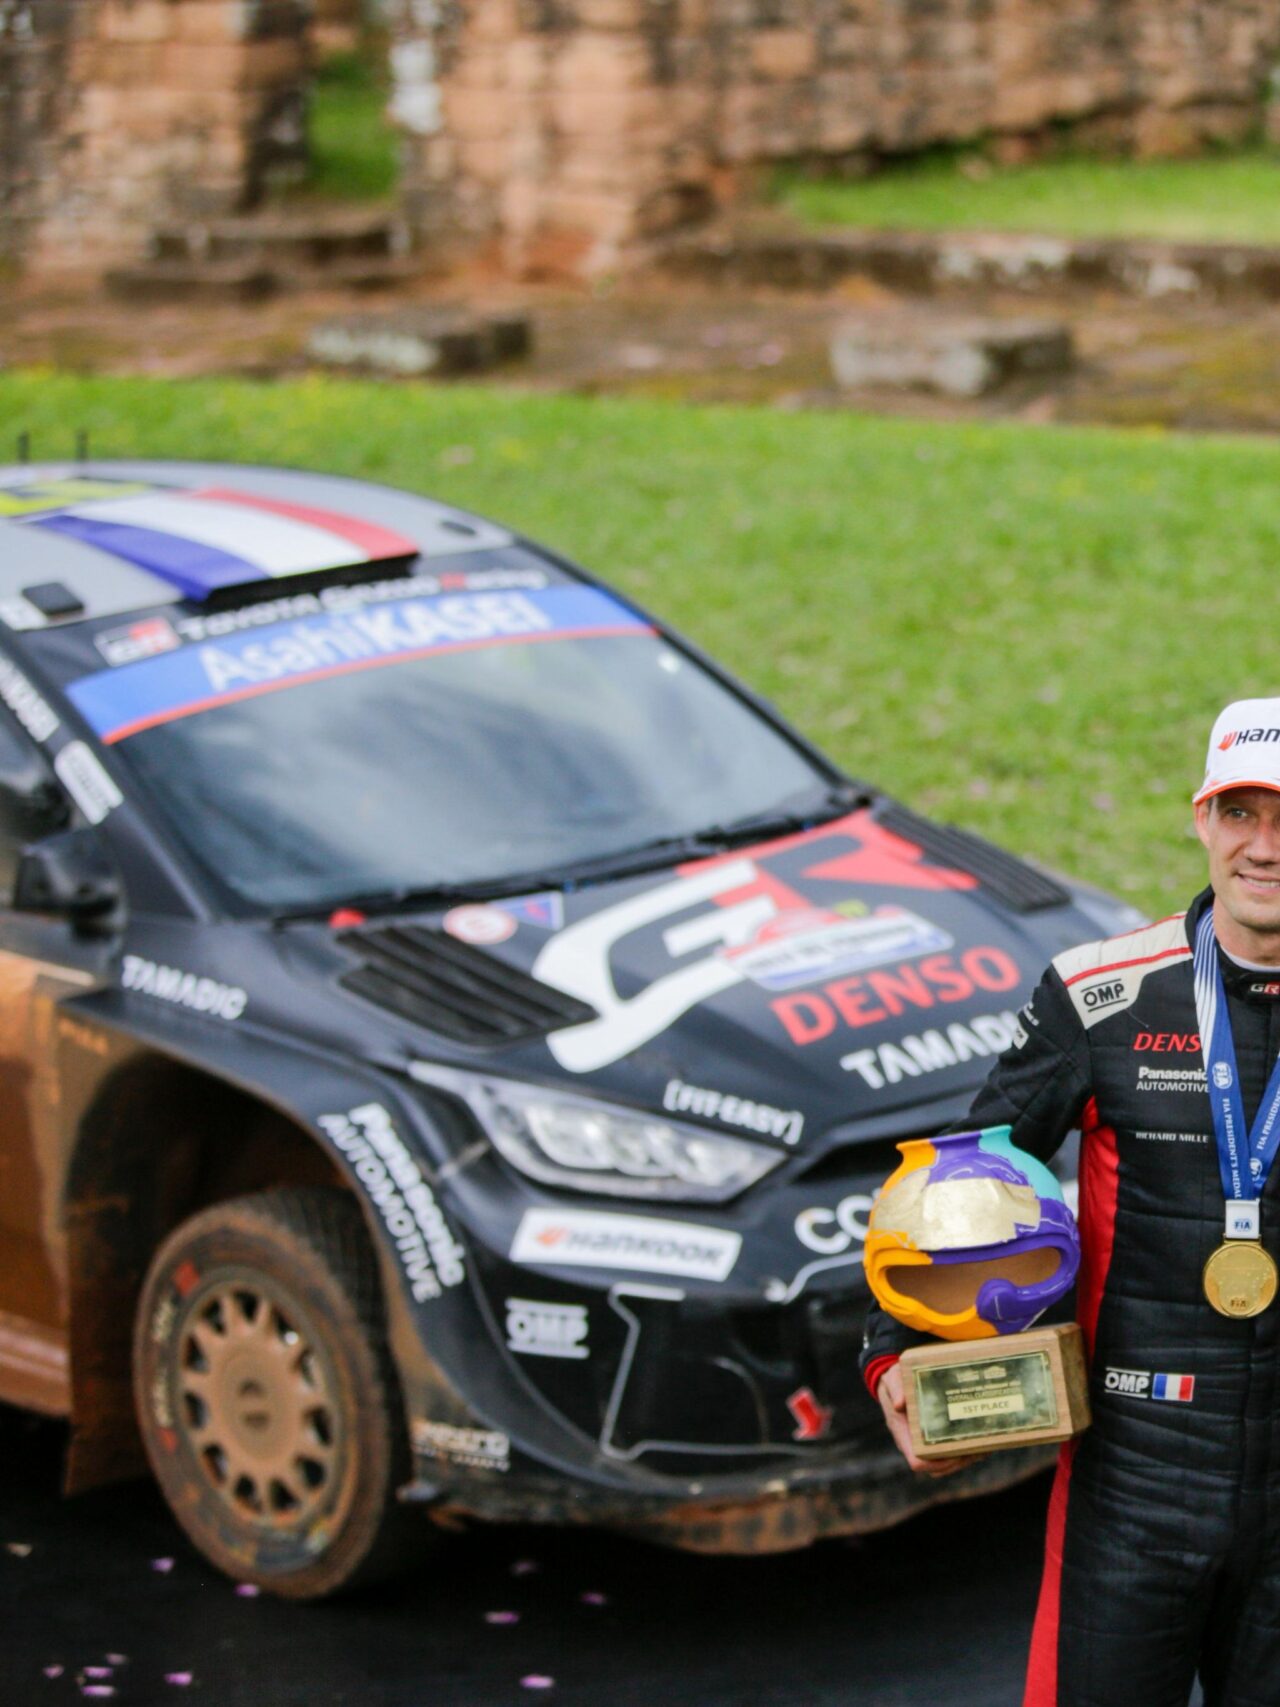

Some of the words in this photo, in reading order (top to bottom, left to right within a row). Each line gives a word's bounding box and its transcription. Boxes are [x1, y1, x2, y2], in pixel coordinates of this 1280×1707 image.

[121, 954, 248, 1021] TAMADIC
[769, 946, 1021, 1046] DENSO
[1083, 983, 1124, 1006] OMP
[839, 1009, 1020, 1090] TAMADI
[1133, 1032, 1202, 1053] DENS
[1138, 1066, 1208, 1081] Panasonic
[1179, 1133, 1208, 1144] MILLE
[317, 1114, 443, 1304] AUTOMOTIVE
[794, 1187, 880, 1255] CC
[1233, 1220, 1251, 1230] FIA
[506, 1306, 589, 1348] OMP
[1104, 1371, 1150, 1393] OMP
